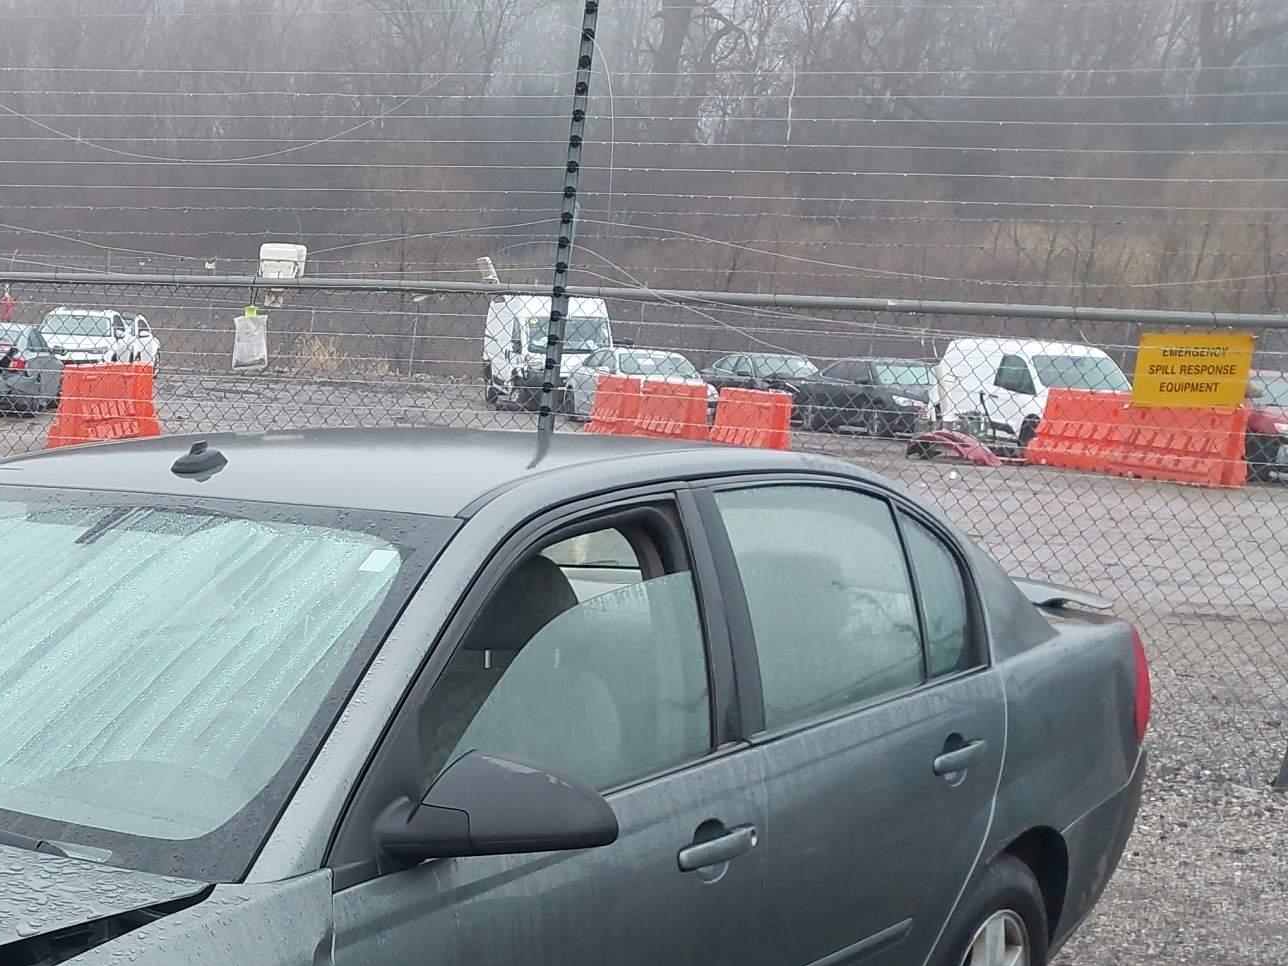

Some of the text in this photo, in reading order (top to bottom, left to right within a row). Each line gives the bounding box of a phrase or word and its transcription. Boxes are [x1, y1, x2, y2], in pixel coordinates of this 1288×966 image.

[1162, 346, 1229, 357] EMERGENCY
[1148, 364, 1237, 375] SPILL RESPONSE
[1159, 382, 1220, 393] EQUIPMENT
